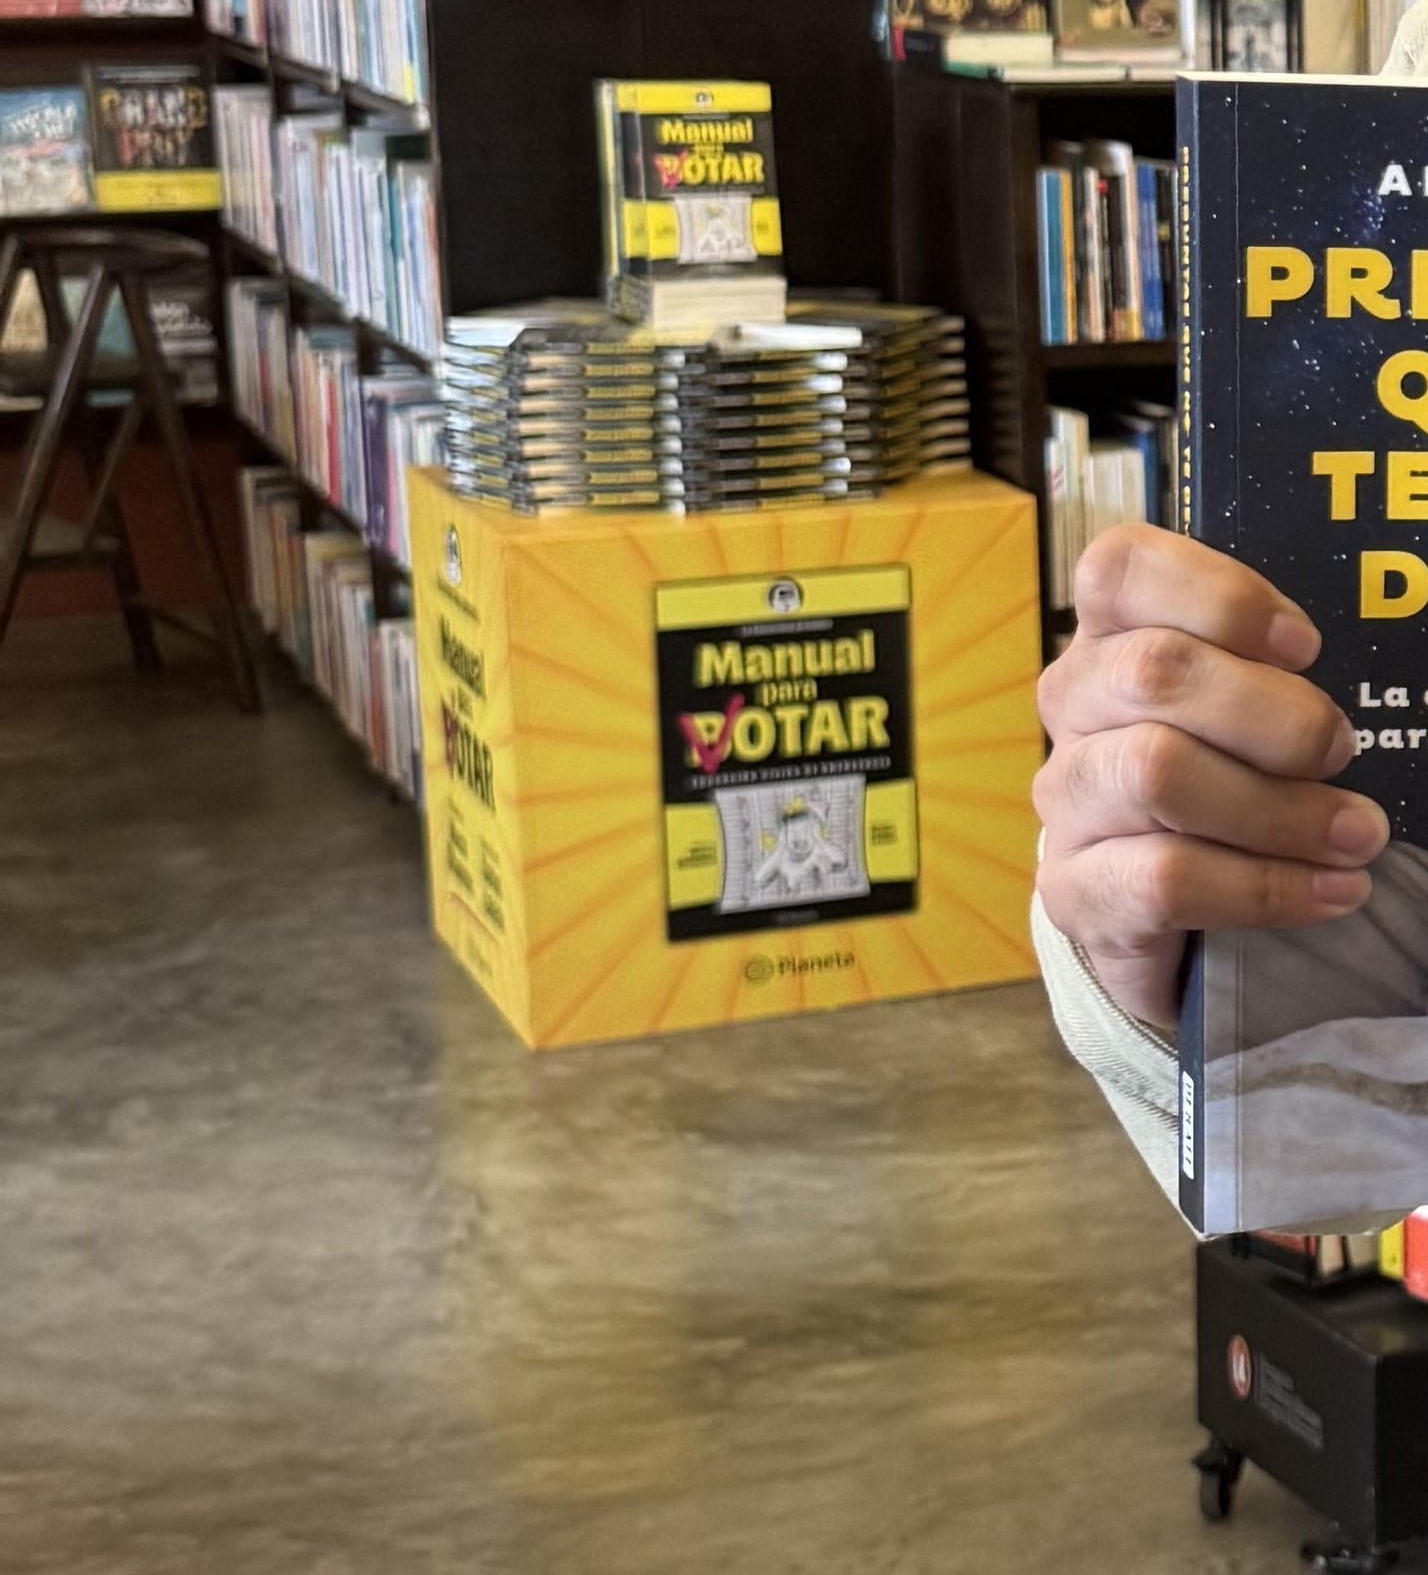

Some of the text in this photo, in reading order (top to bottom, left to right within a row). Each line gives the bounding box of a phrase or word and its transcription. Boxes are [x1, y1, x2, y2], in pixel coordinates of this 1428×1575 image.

[658, 117, 754, 145] Manual
[694, 628, 876, 688] Manual
[758, 679, 818, 707] para
[1359, 682, 1410, 708] La
[777, 950, 856, 977] Planeta
